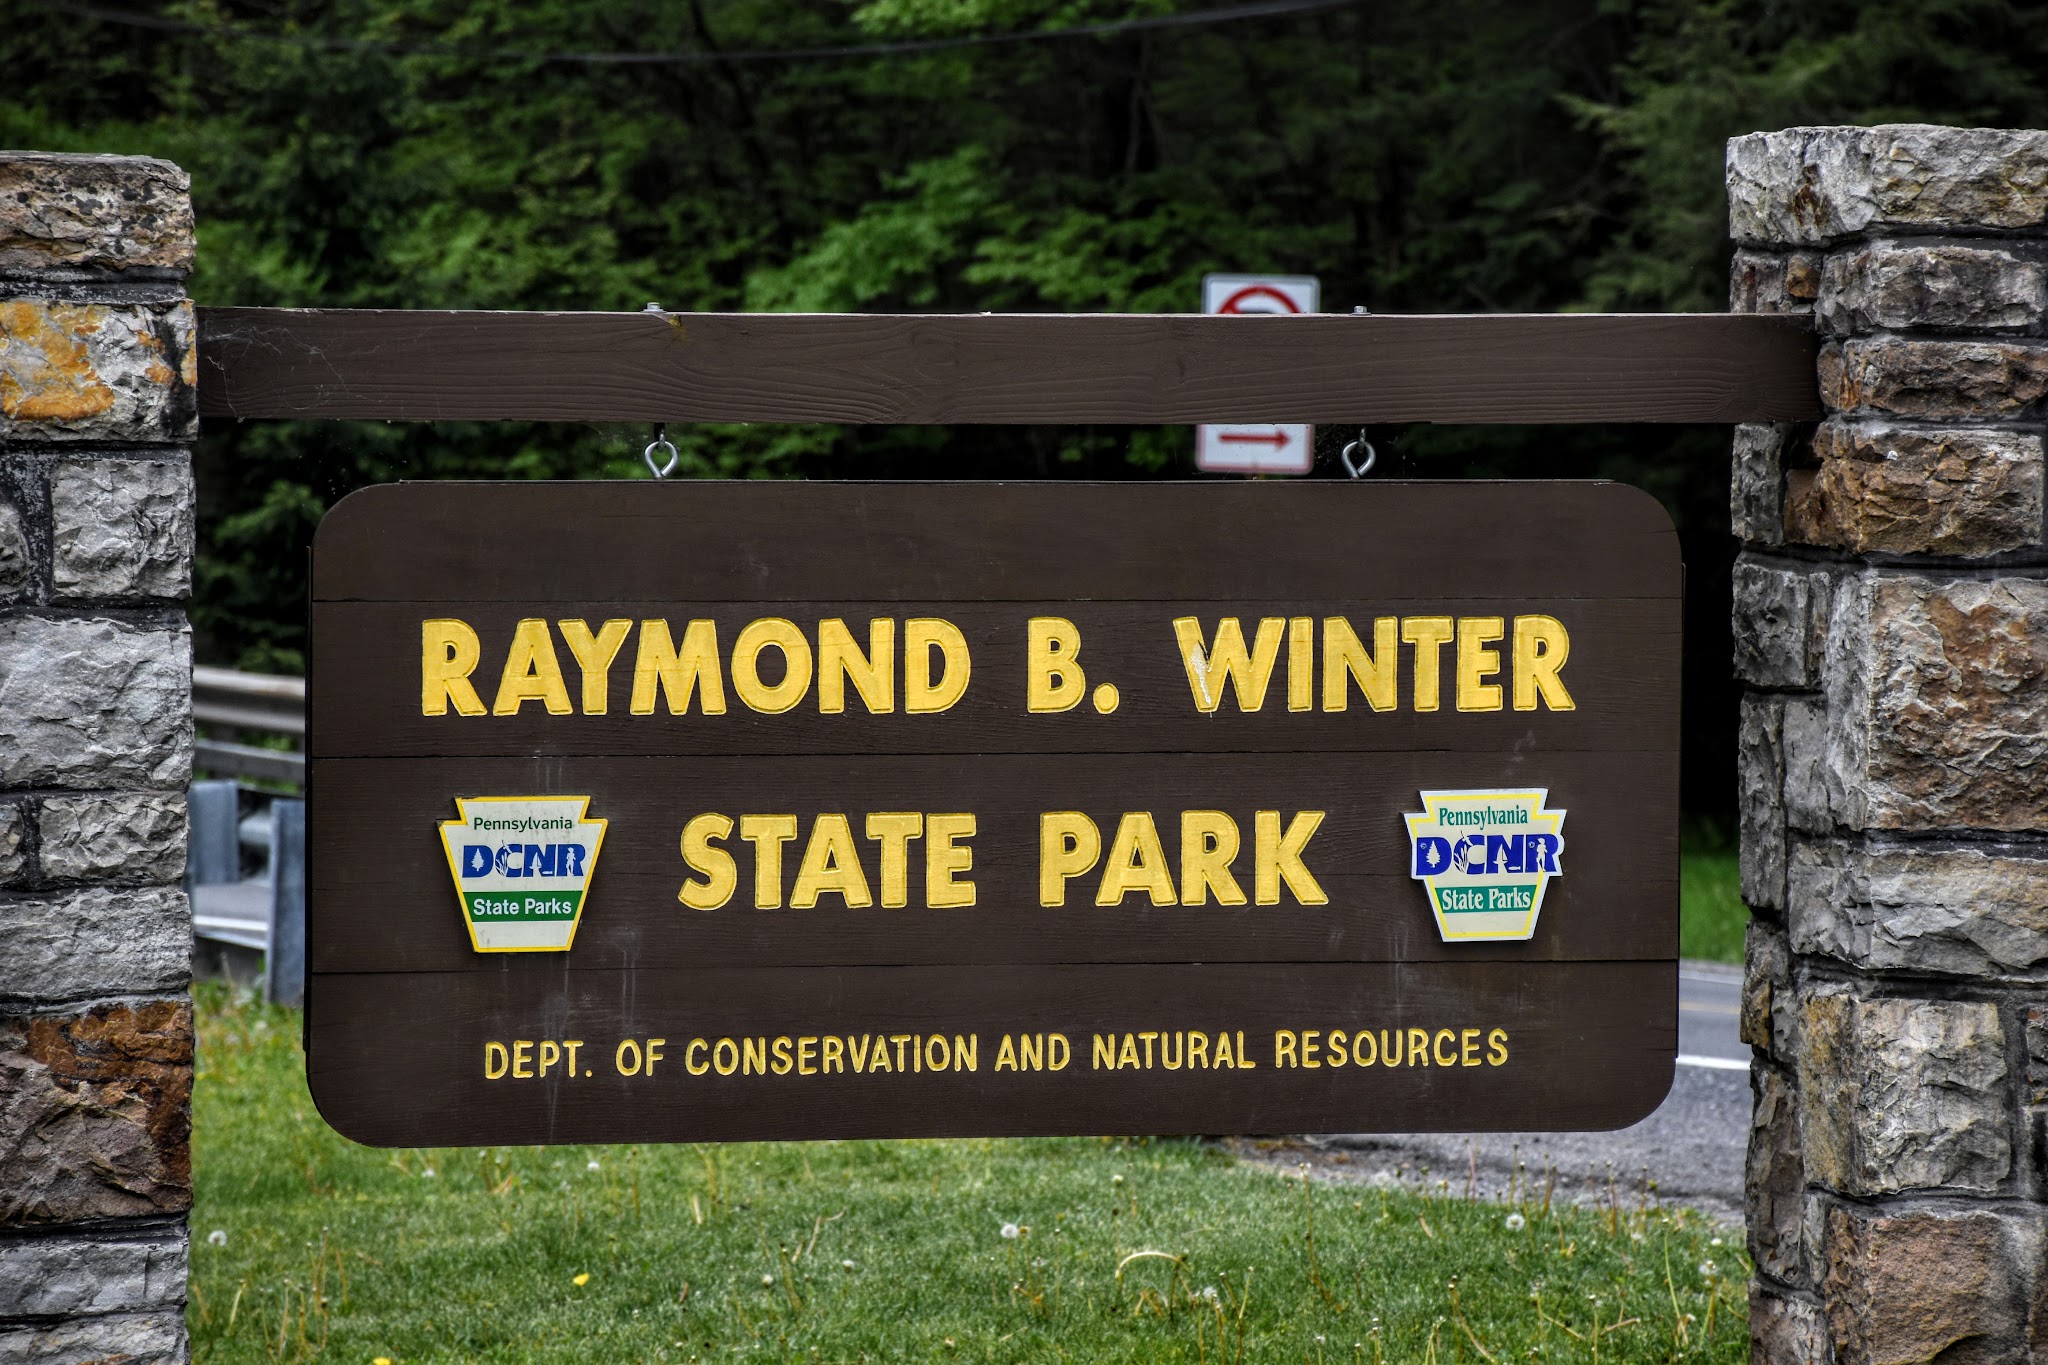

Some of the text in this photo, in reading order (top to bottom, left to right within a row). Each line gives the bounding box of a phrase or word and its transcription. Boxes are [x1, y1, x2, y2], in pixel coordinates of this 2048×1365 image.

[421, 613, 1577, 717] RAYMOND B. WINTER
[473, 816, 573, 833] Pennsylvania
[1439, 804, 1529, 831] Pennsylvania
[462, 842, 586, 878] DCNR
[677, 809, 1329, 911] STATE PARK
[1416, 833, 1559, 876] DCNR
[473, 898, 572, 916] State Parks
[1442, 887, 1531, 911] State Parks
[484, 1027, 1509, 1080] DEPT. OF CONSERVATION AND NATURAL RESOURCES
